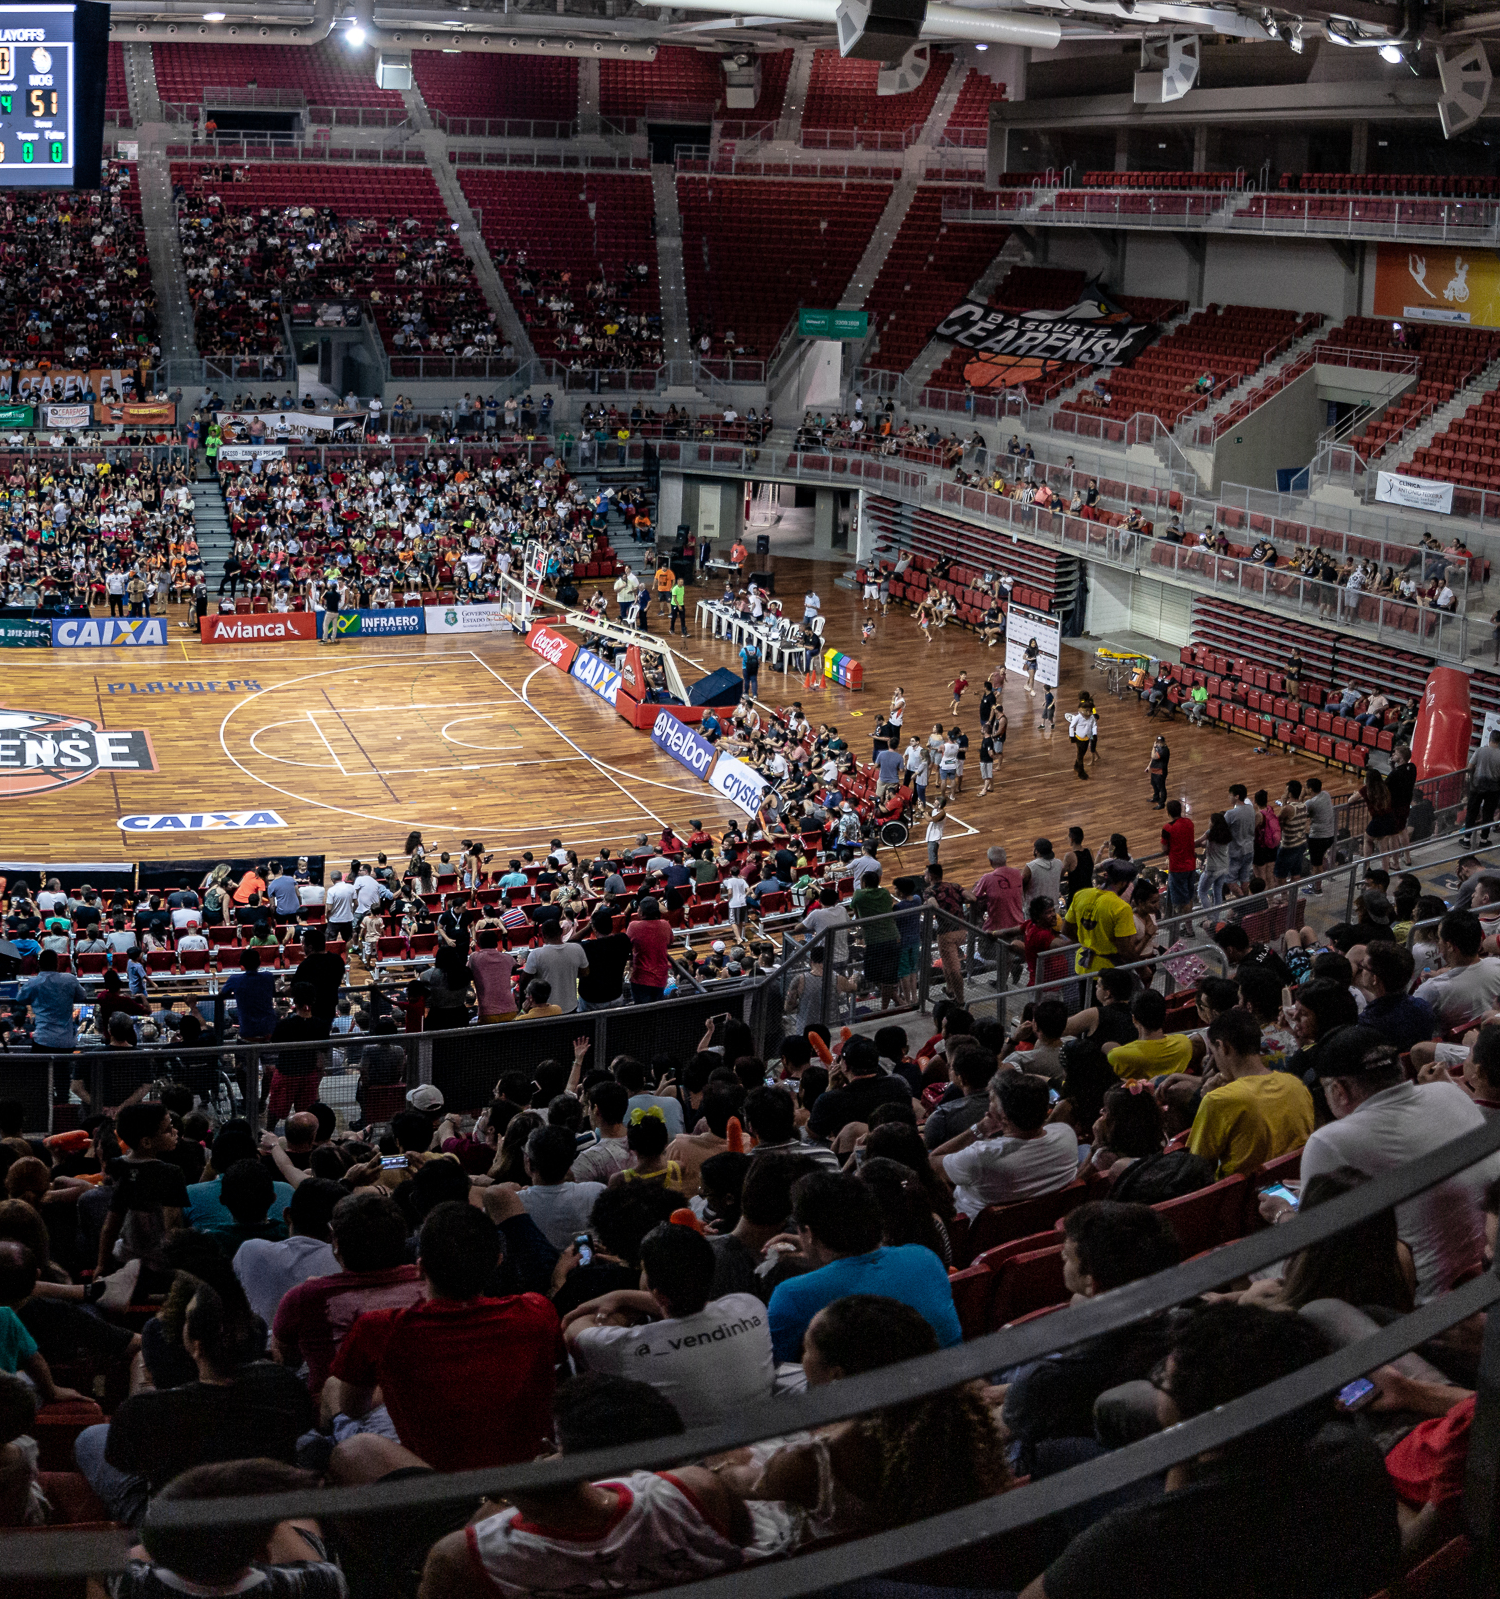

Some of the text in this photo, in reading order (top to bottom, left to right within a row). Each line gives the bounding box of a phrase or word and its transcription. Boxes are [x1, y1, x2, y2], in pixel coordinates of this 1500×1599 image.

[29, 74, 53, 86] MOG
[0, 94, 12, 113] 4
[30, 90, 57, 117] 51
[22, 142, 34, 163] 0
[51, 141, 63, 163] 0
[987, 313, 1112, 338] BASQUETE
[18, 375, 111, 398] CEARENE
[361, 615, 419, 628] INFRAERO
[461, 609, 490, 617] GOVERNO
[57, 620, 164, 646] CAIXA
[214, 621, 285, 639] Avianca
[362, 625, 419, 633] AEROPORTOS
[107, 679, 264, 695] PLAYOFFS
[574, 652, 622, 705] CAIXA
[661, 717, 713, 772] Helbor
[723, 773, 761, 814] crysta
[122, 812, 280, 830] CAIXA
[634, 1315, 762, 1358] @_vendinha
